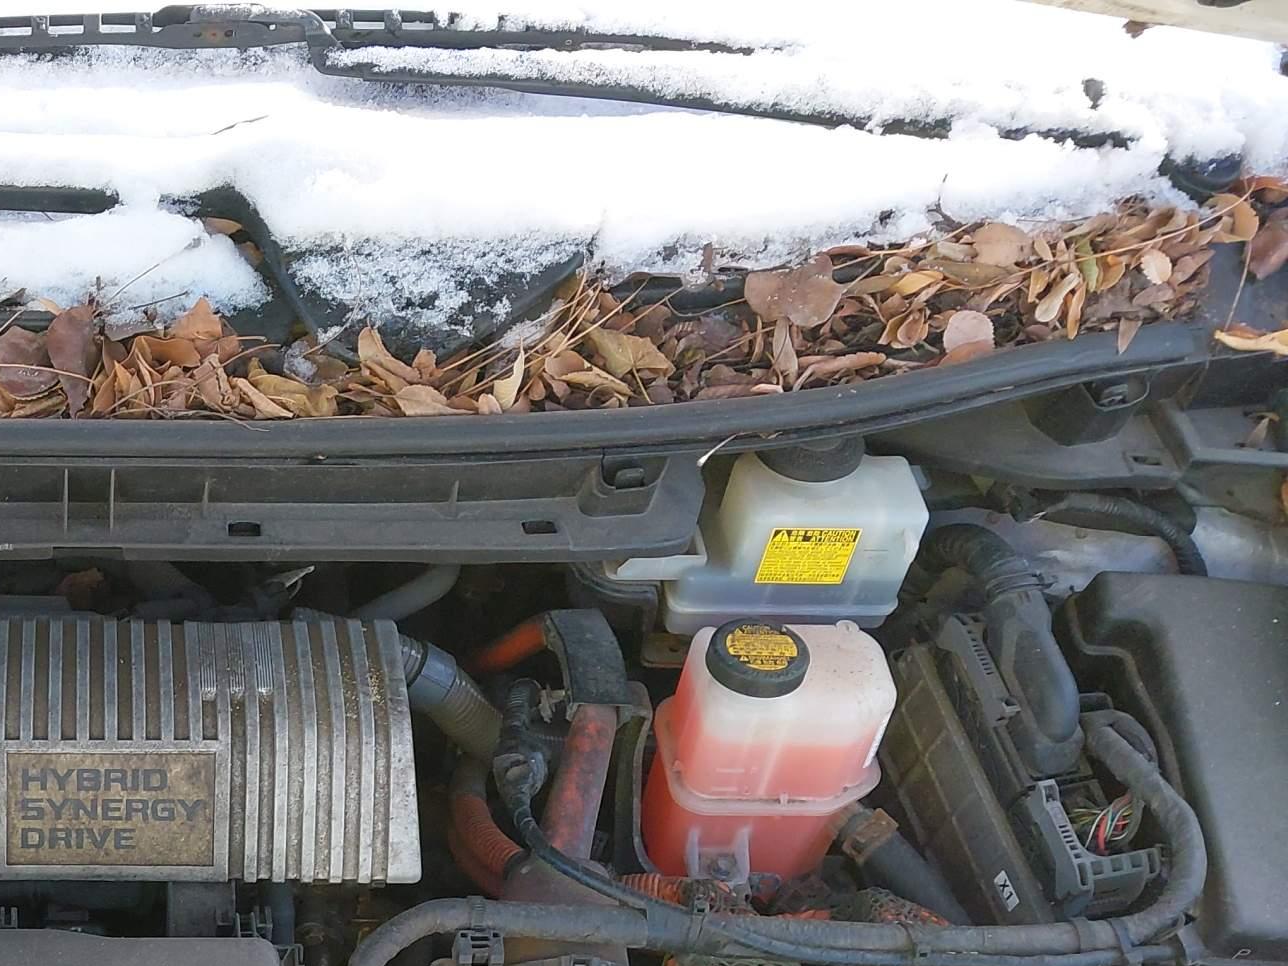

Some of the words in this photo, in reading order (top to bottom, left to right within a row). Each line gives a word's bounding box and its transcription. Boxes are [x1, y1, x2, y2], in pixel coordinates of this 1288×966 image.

[20, 768, 169, 792] HYBRID
[20, 798, 203, 822] SYNERGY
[20, 827, 137, 850] DRIVE
[998, 879, 1014, 901] X1
